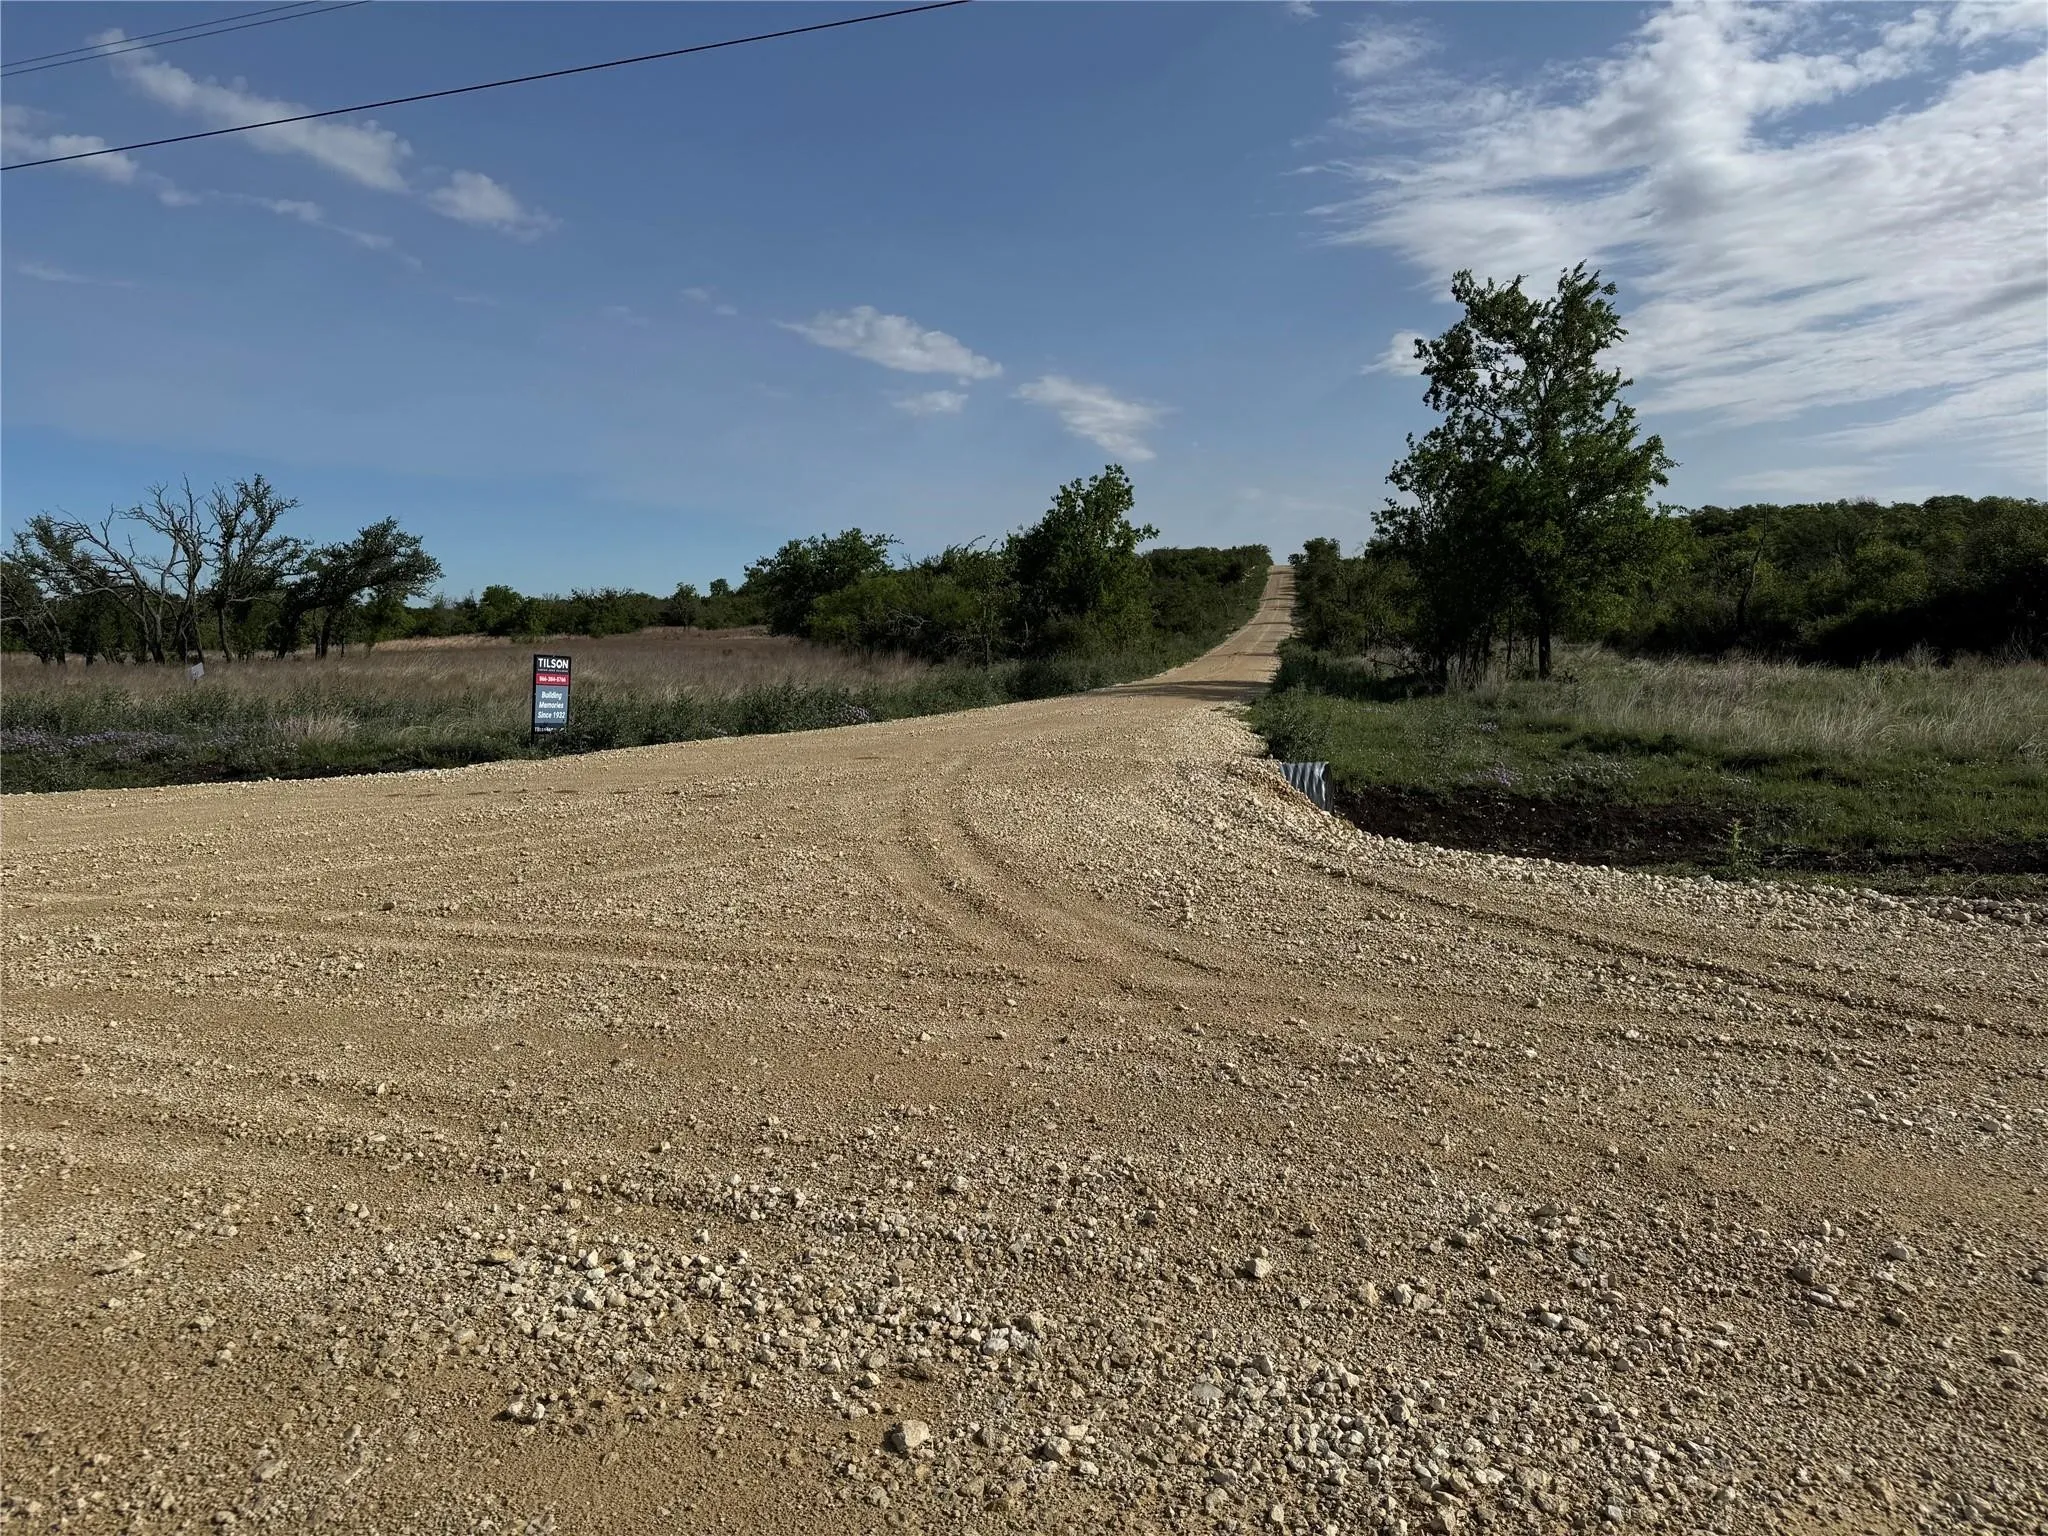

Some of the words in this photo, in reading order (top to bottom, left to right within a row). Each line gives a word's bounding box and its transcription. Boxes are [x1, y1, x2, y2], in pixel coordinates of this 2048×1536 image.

[538, 658, 568, 669] TILSON
[541, 690, 562, 700] Building
[537, 711, 552, 719] Since
[553, 711, 566, 719] 1932
